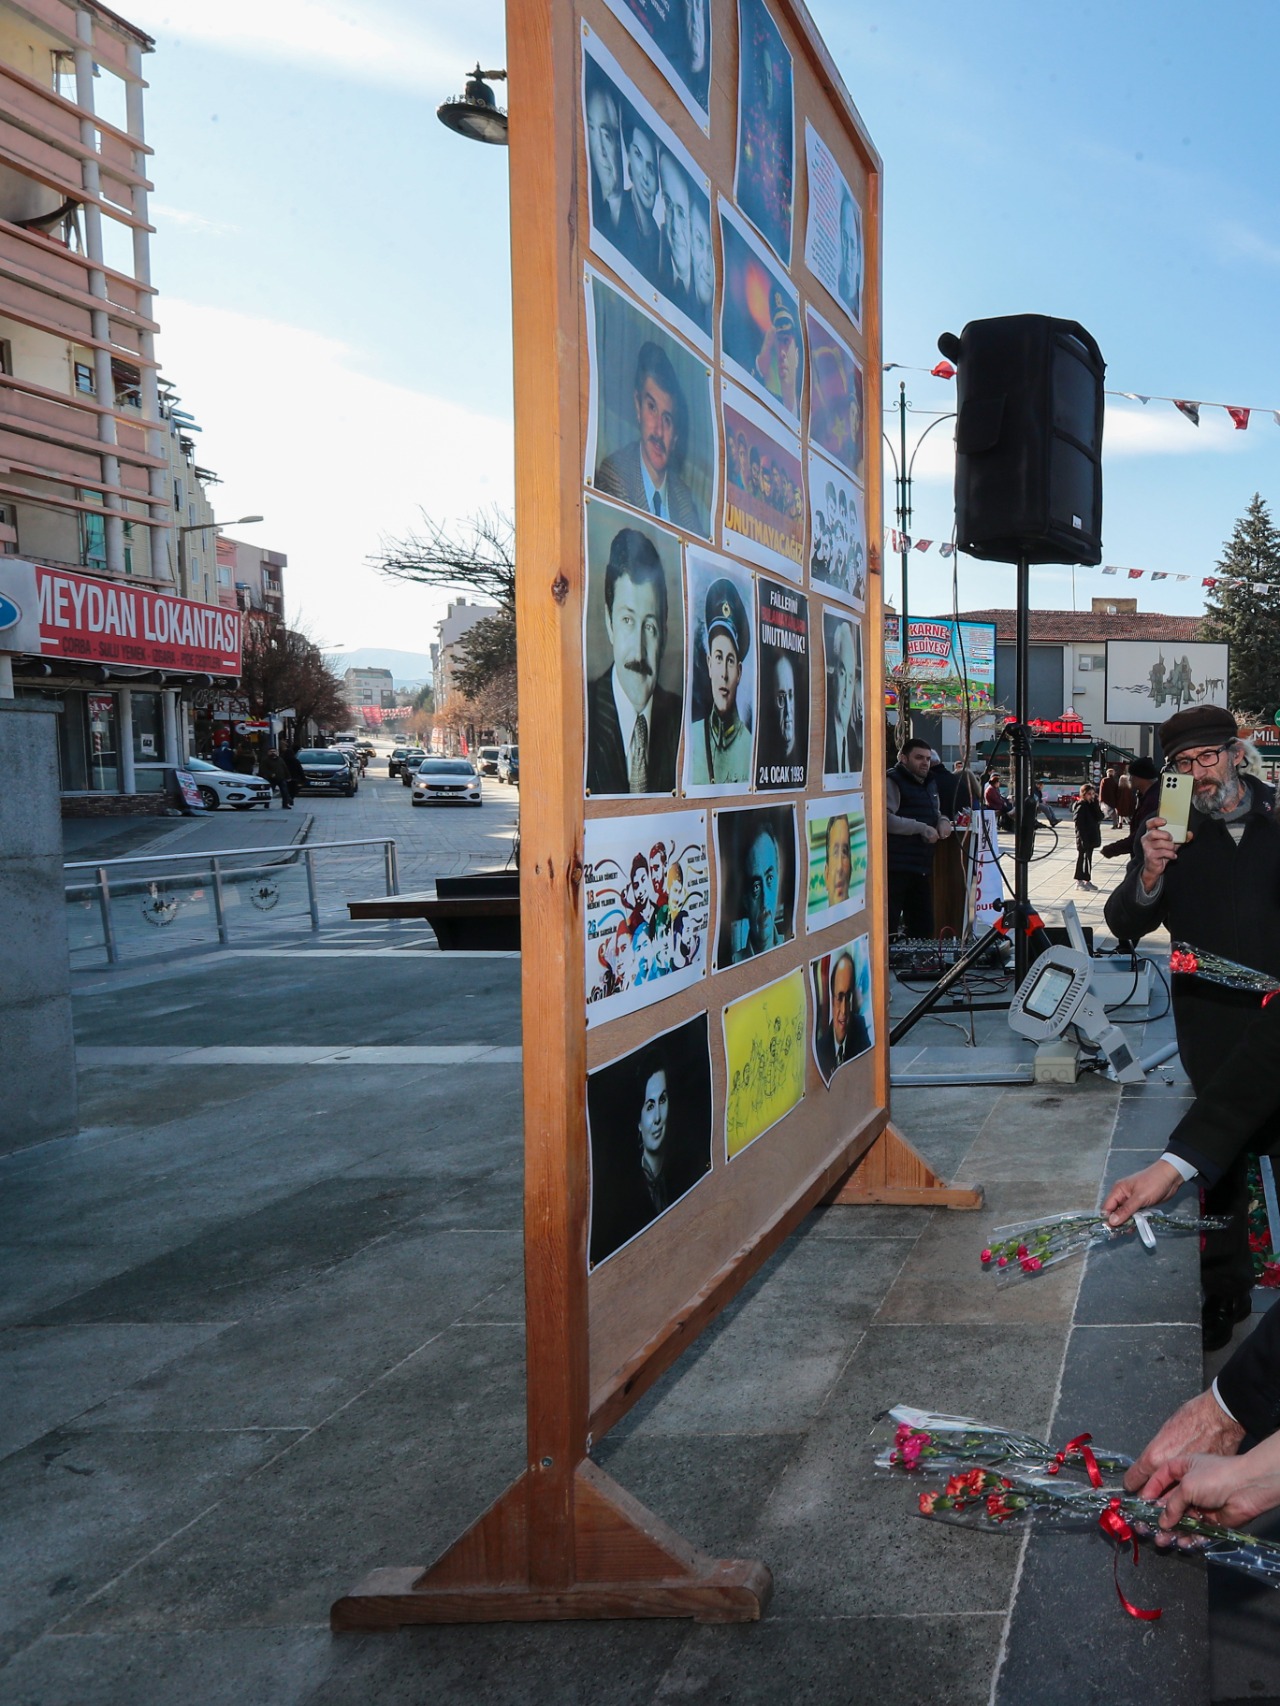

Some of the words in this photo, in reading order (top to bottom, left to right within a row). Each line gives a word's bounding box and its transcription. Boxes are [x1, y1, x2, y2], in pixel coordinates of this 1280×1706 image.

[725, 502, 803, 565] UNUTMAYACAĞIZ
[38, 574, 137, 639] MEYDAN
[143, 597, 239, 653] LOKANTASI
[762, 623, 806, 655] UNUTMADIK!
[909, 623, 948, 640] KARNE
[908, 638, 951, 657] HEDİYESİ
[759, 766, 769, 784] 24
[770, 765, 790, 784] OCAK
[790, 765, 804, 783] 1993
